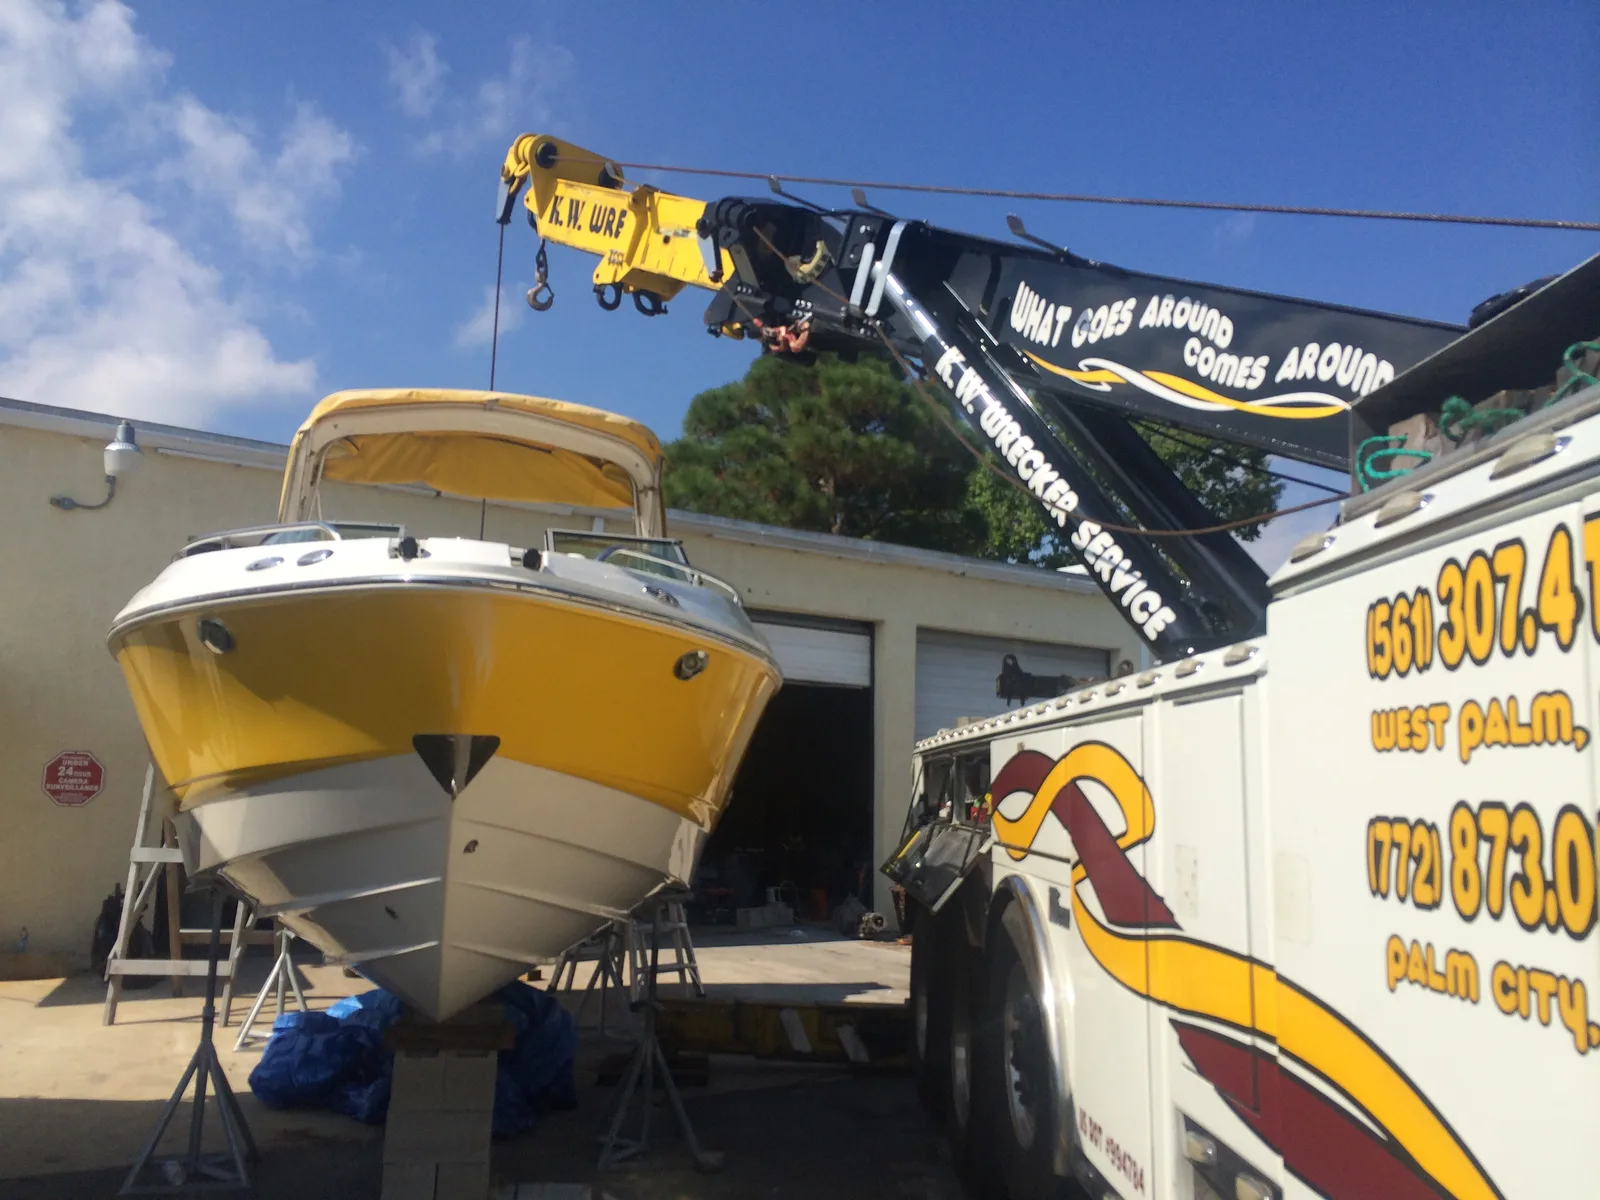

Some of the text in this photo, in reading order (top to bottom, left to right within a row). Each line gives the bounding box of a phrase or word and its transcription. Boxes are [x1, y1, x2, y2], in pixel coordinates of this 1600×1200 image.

[589, 203, 627, 238] WRE
[1010, 280, 1234, 349] WHAT GOES AROUND
[1183, 337, 1270, 390] COMES
[980, 405, 1079, 528] WRECKER
[1071, 520, 1177, 641] SERVICE
[1371, 689, 1591, 764] WEST PALM,
[45, 783, 99, 791] SURVEILLANCE
[57, 766, 73, 777] 24
[1450, 800, 1600, 942] 873.0
[1386, 934, 1480, 1005] PALM
[1089, 1115, 1103, 1152] DOT
